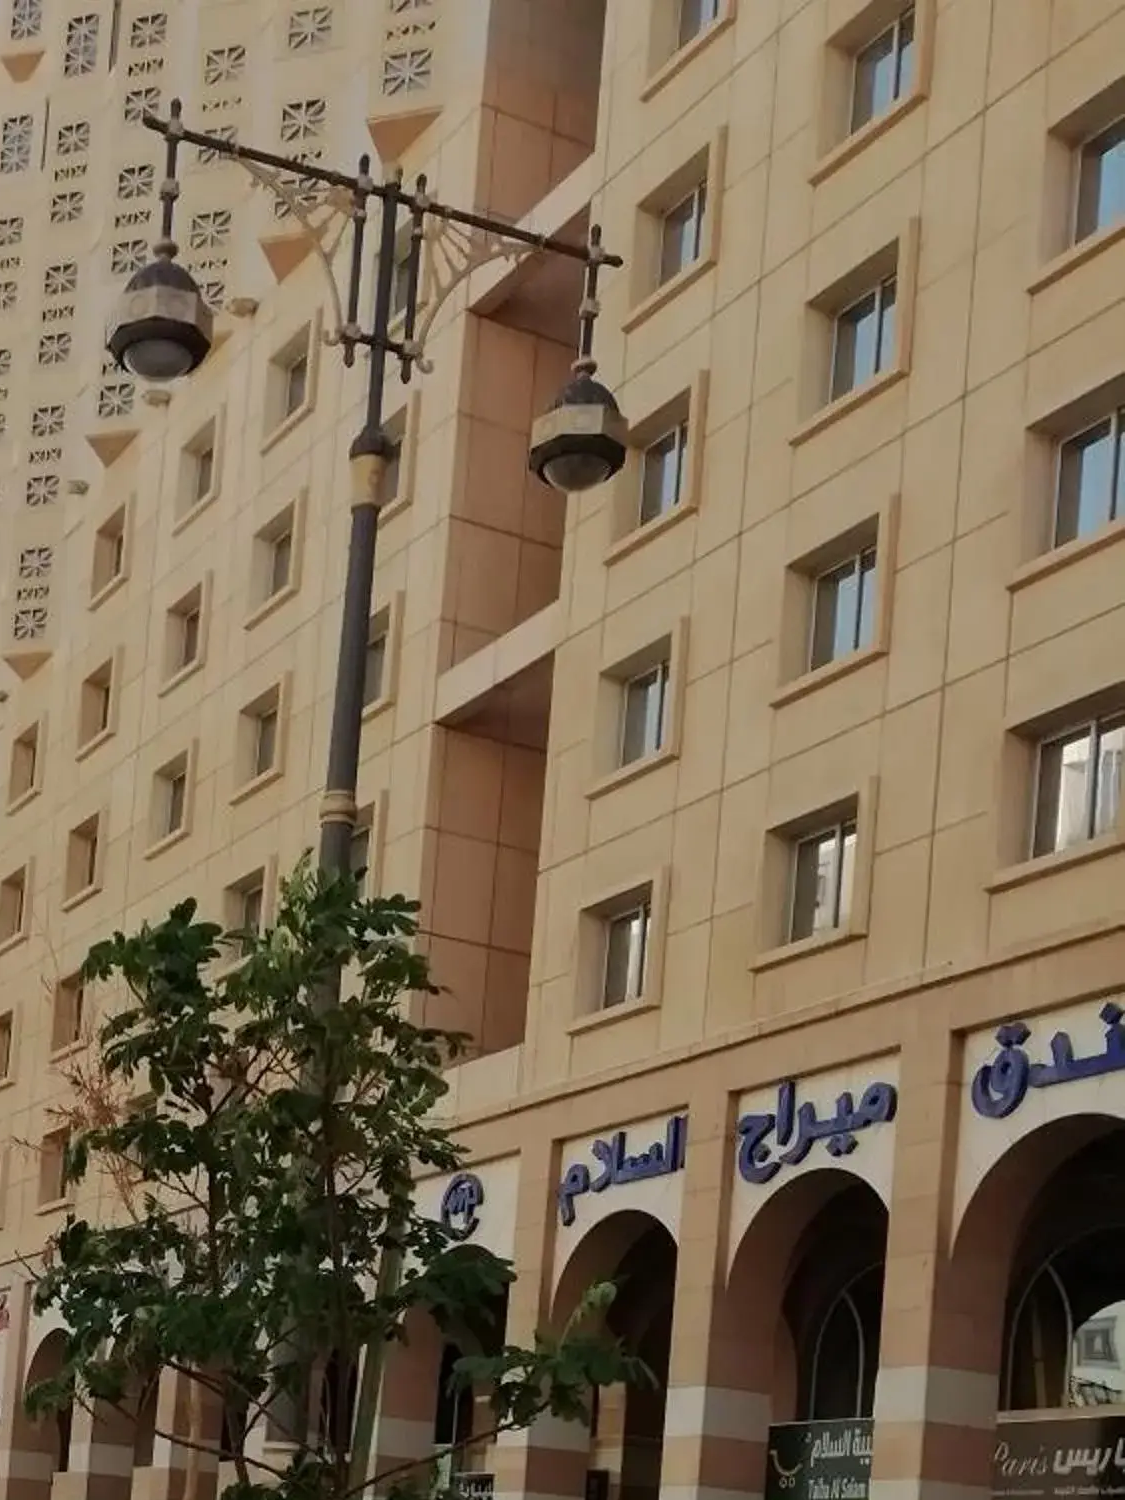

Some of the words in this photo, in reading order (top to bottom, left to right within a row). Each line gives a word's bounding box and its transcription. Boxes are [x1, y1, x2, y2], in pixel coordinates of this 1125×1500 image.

[971, 1001, 1125, 1119] ندق
[559, 1115, 688, 1226] السلام
[738, 1080, 897, 1184] ميراج
[810, 1429, 852, 1468] السلام
[852, 1427, 874, 1466] يبة
